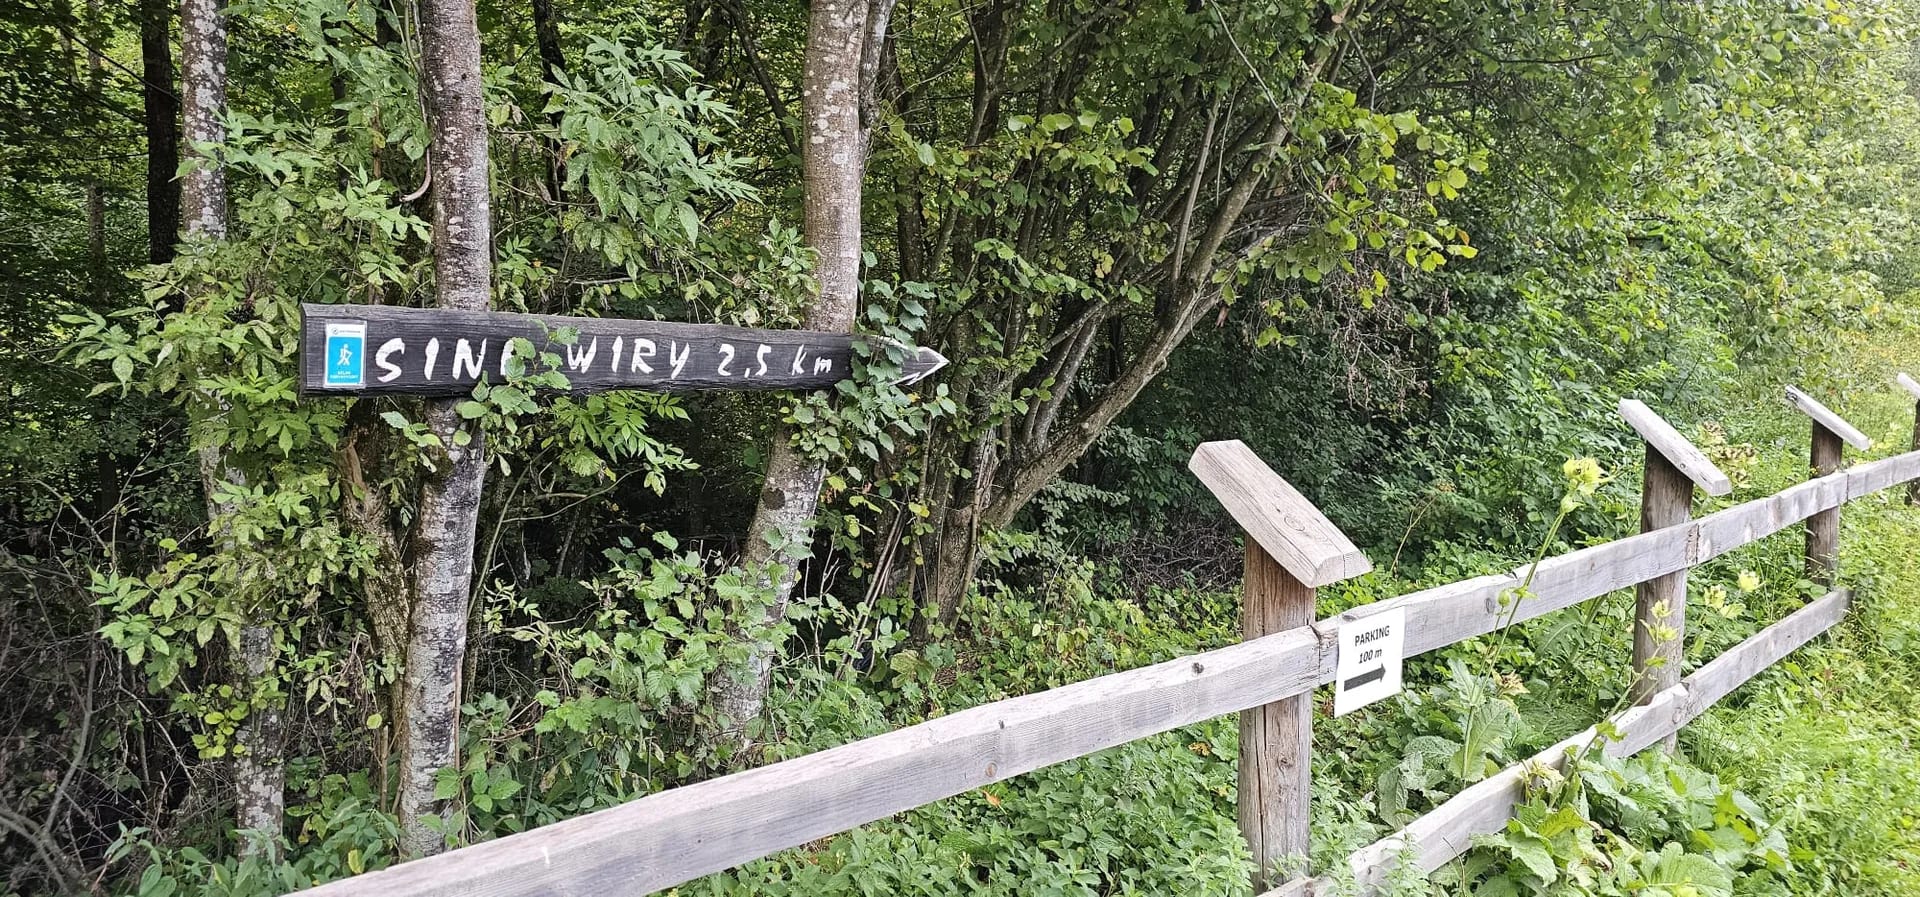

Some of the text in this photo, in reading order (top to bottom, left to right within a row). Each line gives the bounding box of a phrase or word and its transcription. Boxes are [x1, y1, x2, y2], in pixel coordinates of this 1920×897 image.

[566, 336, 691, 380] WIRY
[1354, 625, 1390, 647] PARKING
[1358, 649, 1383, 664] 100 m
